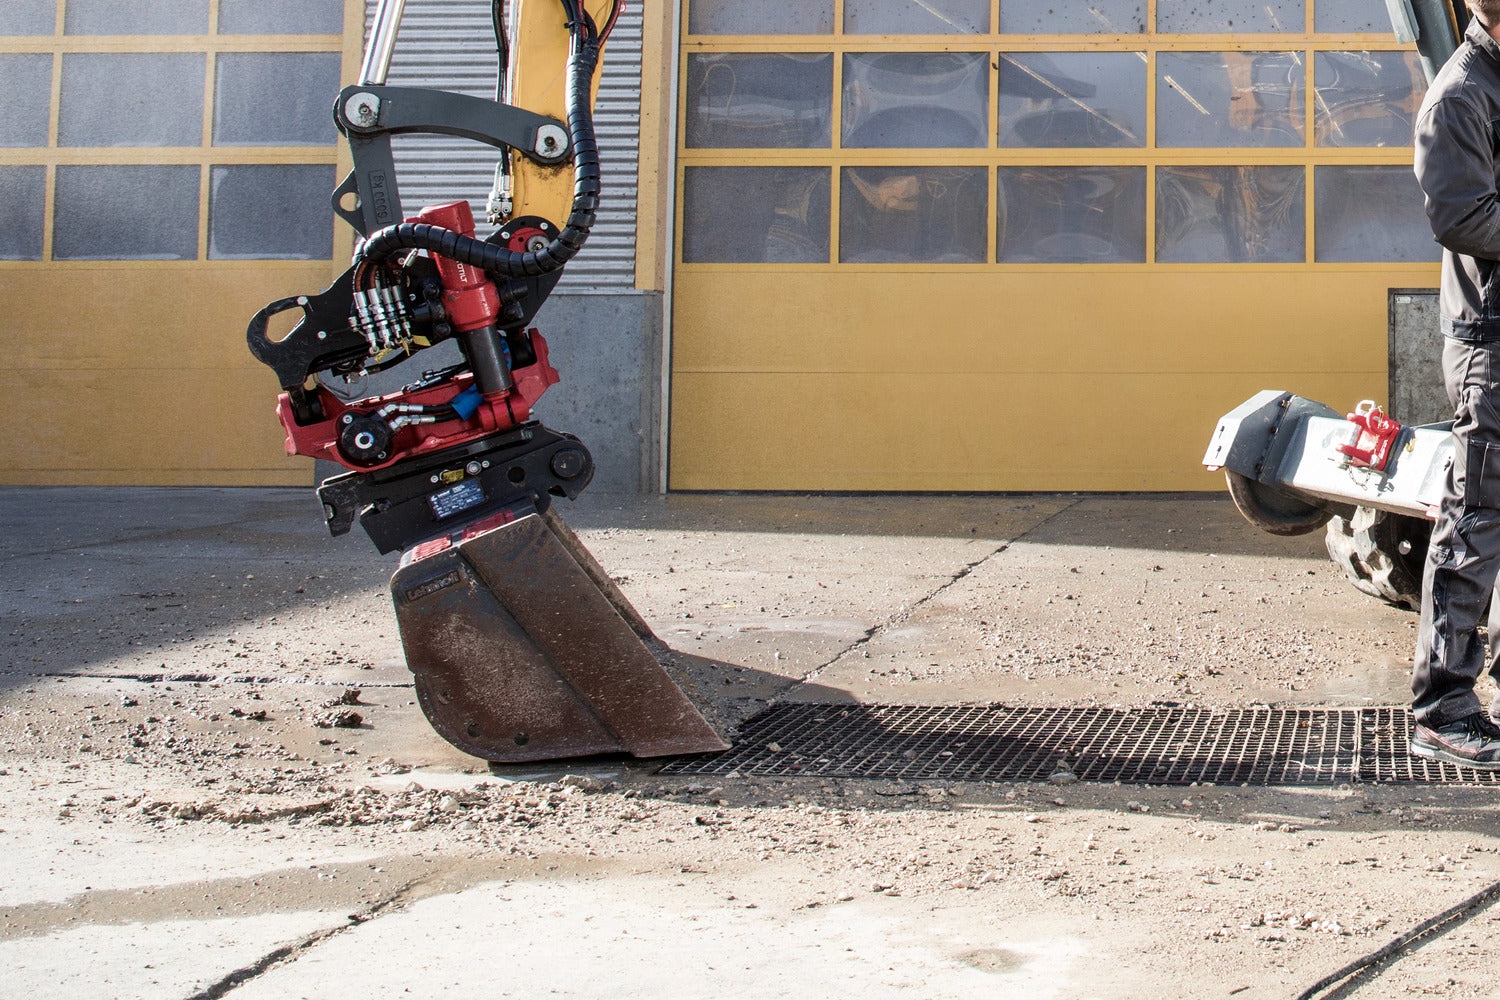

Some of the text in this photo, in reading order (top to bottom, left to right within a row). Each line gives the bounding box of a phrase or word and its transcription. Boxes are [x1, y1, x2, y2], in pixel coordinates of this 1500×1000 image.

[372, 174, 388, 218] 6000 kg
[453, 260, 467, 282] OTILT
